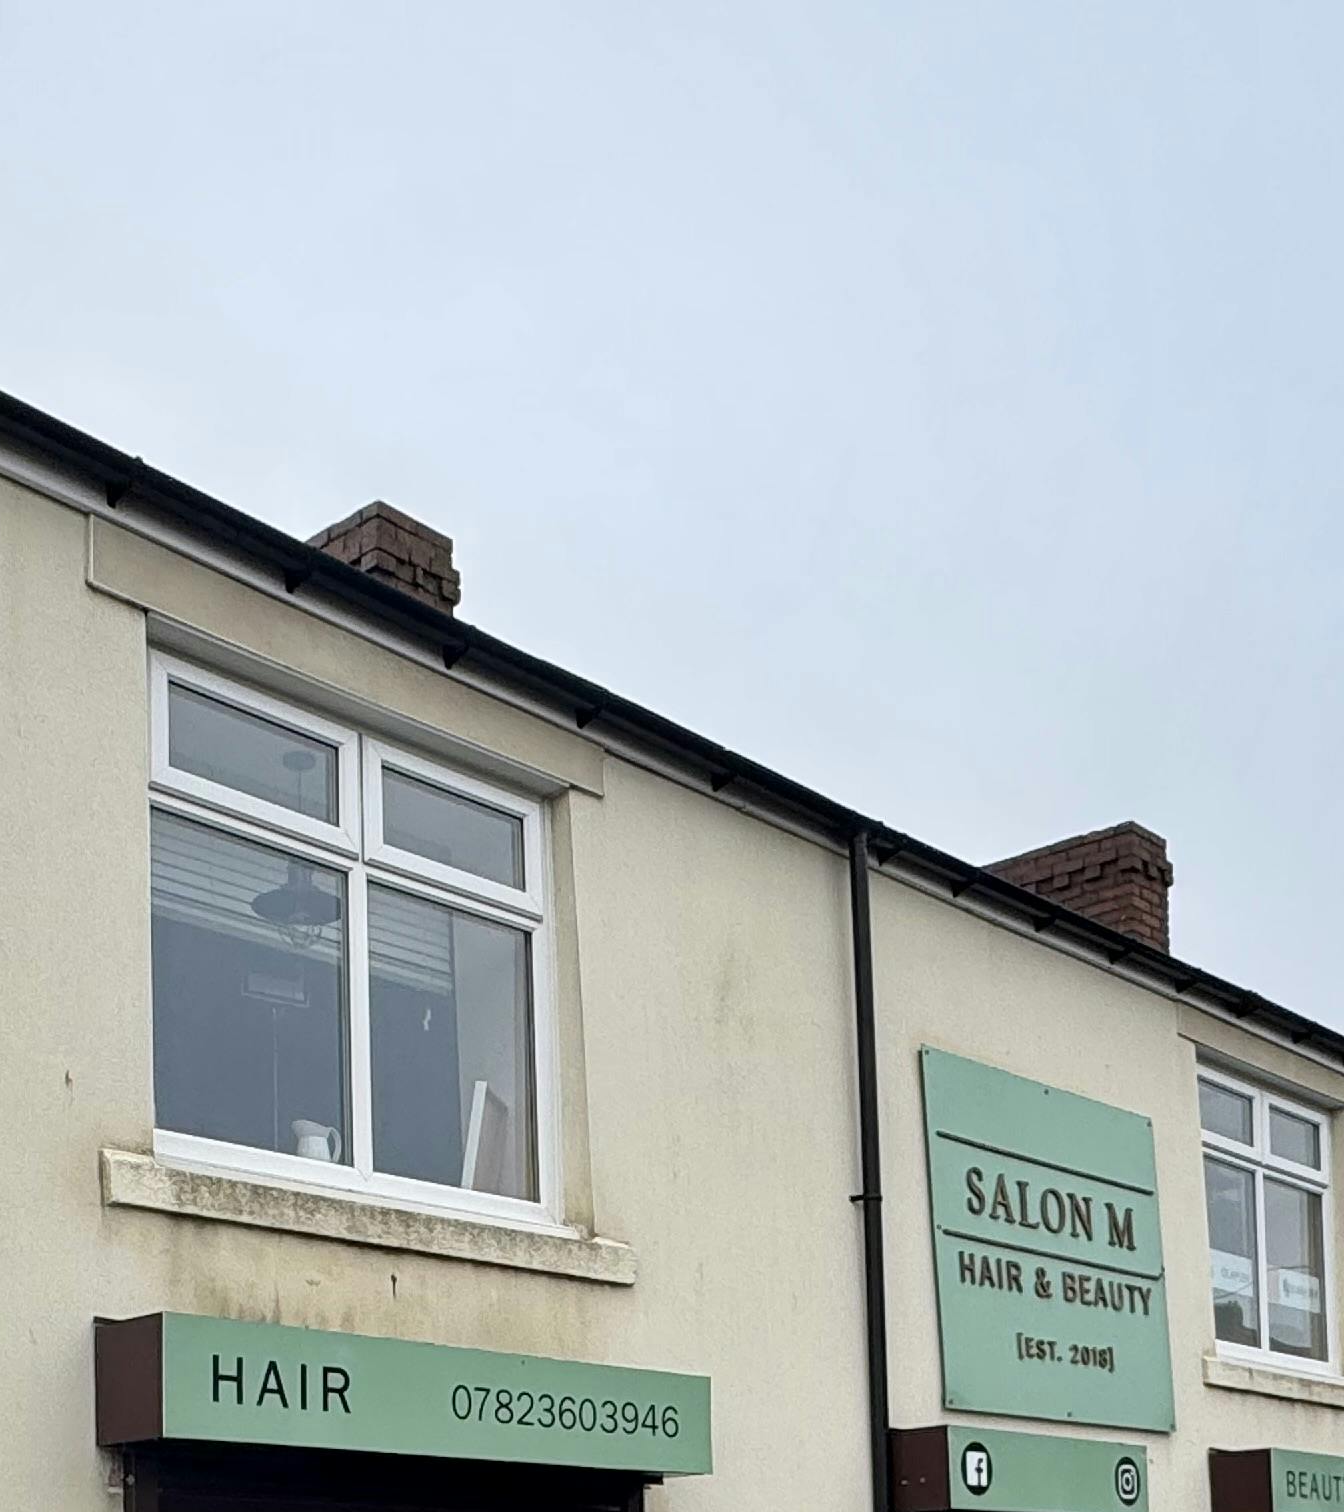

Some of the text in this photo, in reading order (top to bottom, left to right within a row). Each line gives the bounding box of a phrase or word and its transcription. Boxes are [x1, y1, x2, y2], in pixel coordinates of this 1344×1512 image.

[966, 1166, 1137, 1252] SALON M
[958, 1250, 1152, 1316] HAIR & BEAUTY
[210, 1353, 681, 1439] HAIR 07823603946
